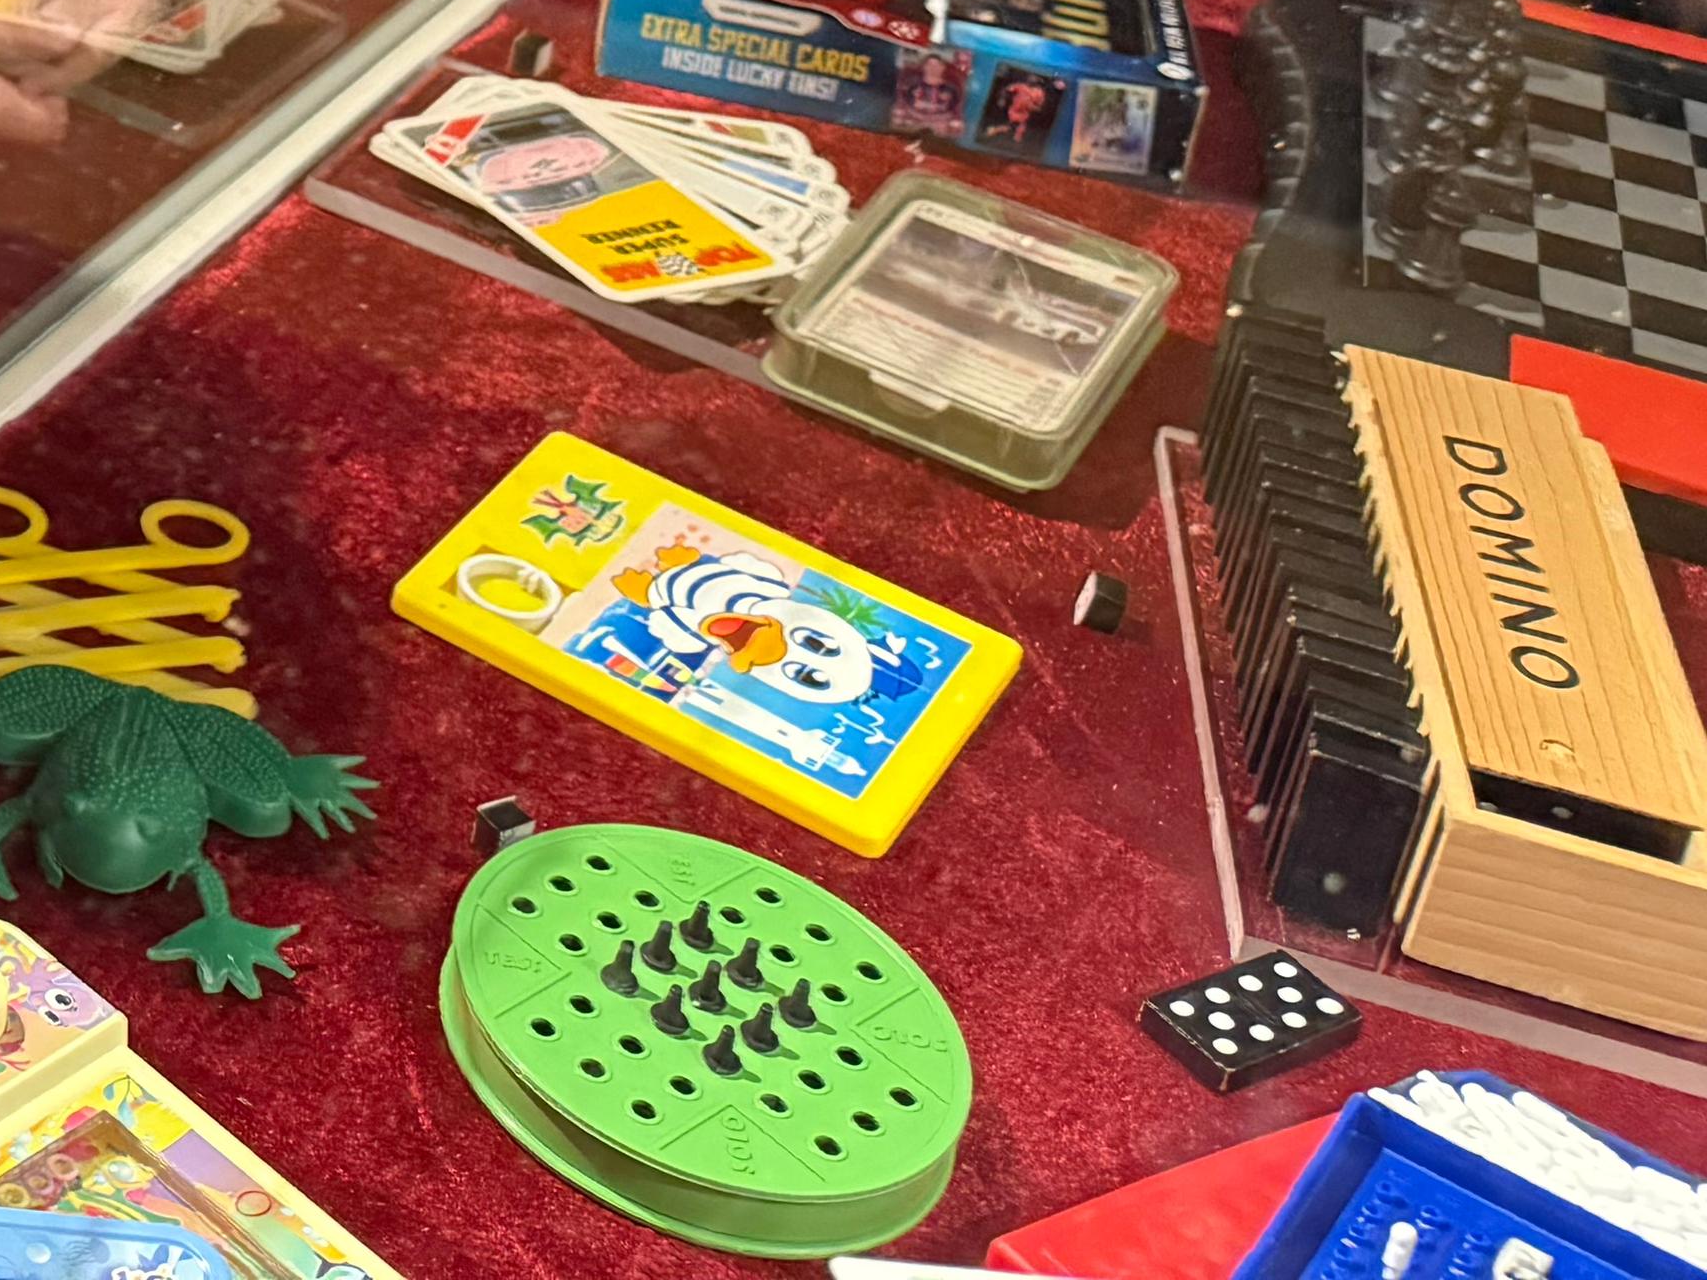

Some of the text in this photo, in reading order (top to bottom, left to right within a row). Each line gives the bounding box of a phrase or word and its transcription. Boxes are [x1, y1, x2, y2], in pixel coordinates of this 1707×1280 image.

[640, 13, 704, 48] EXTRA
[707, 23, 791, 66] SPECIAL
[794, 43, 873, 83] CARDS
[1442, 435, 1580, 689] DOMINO
